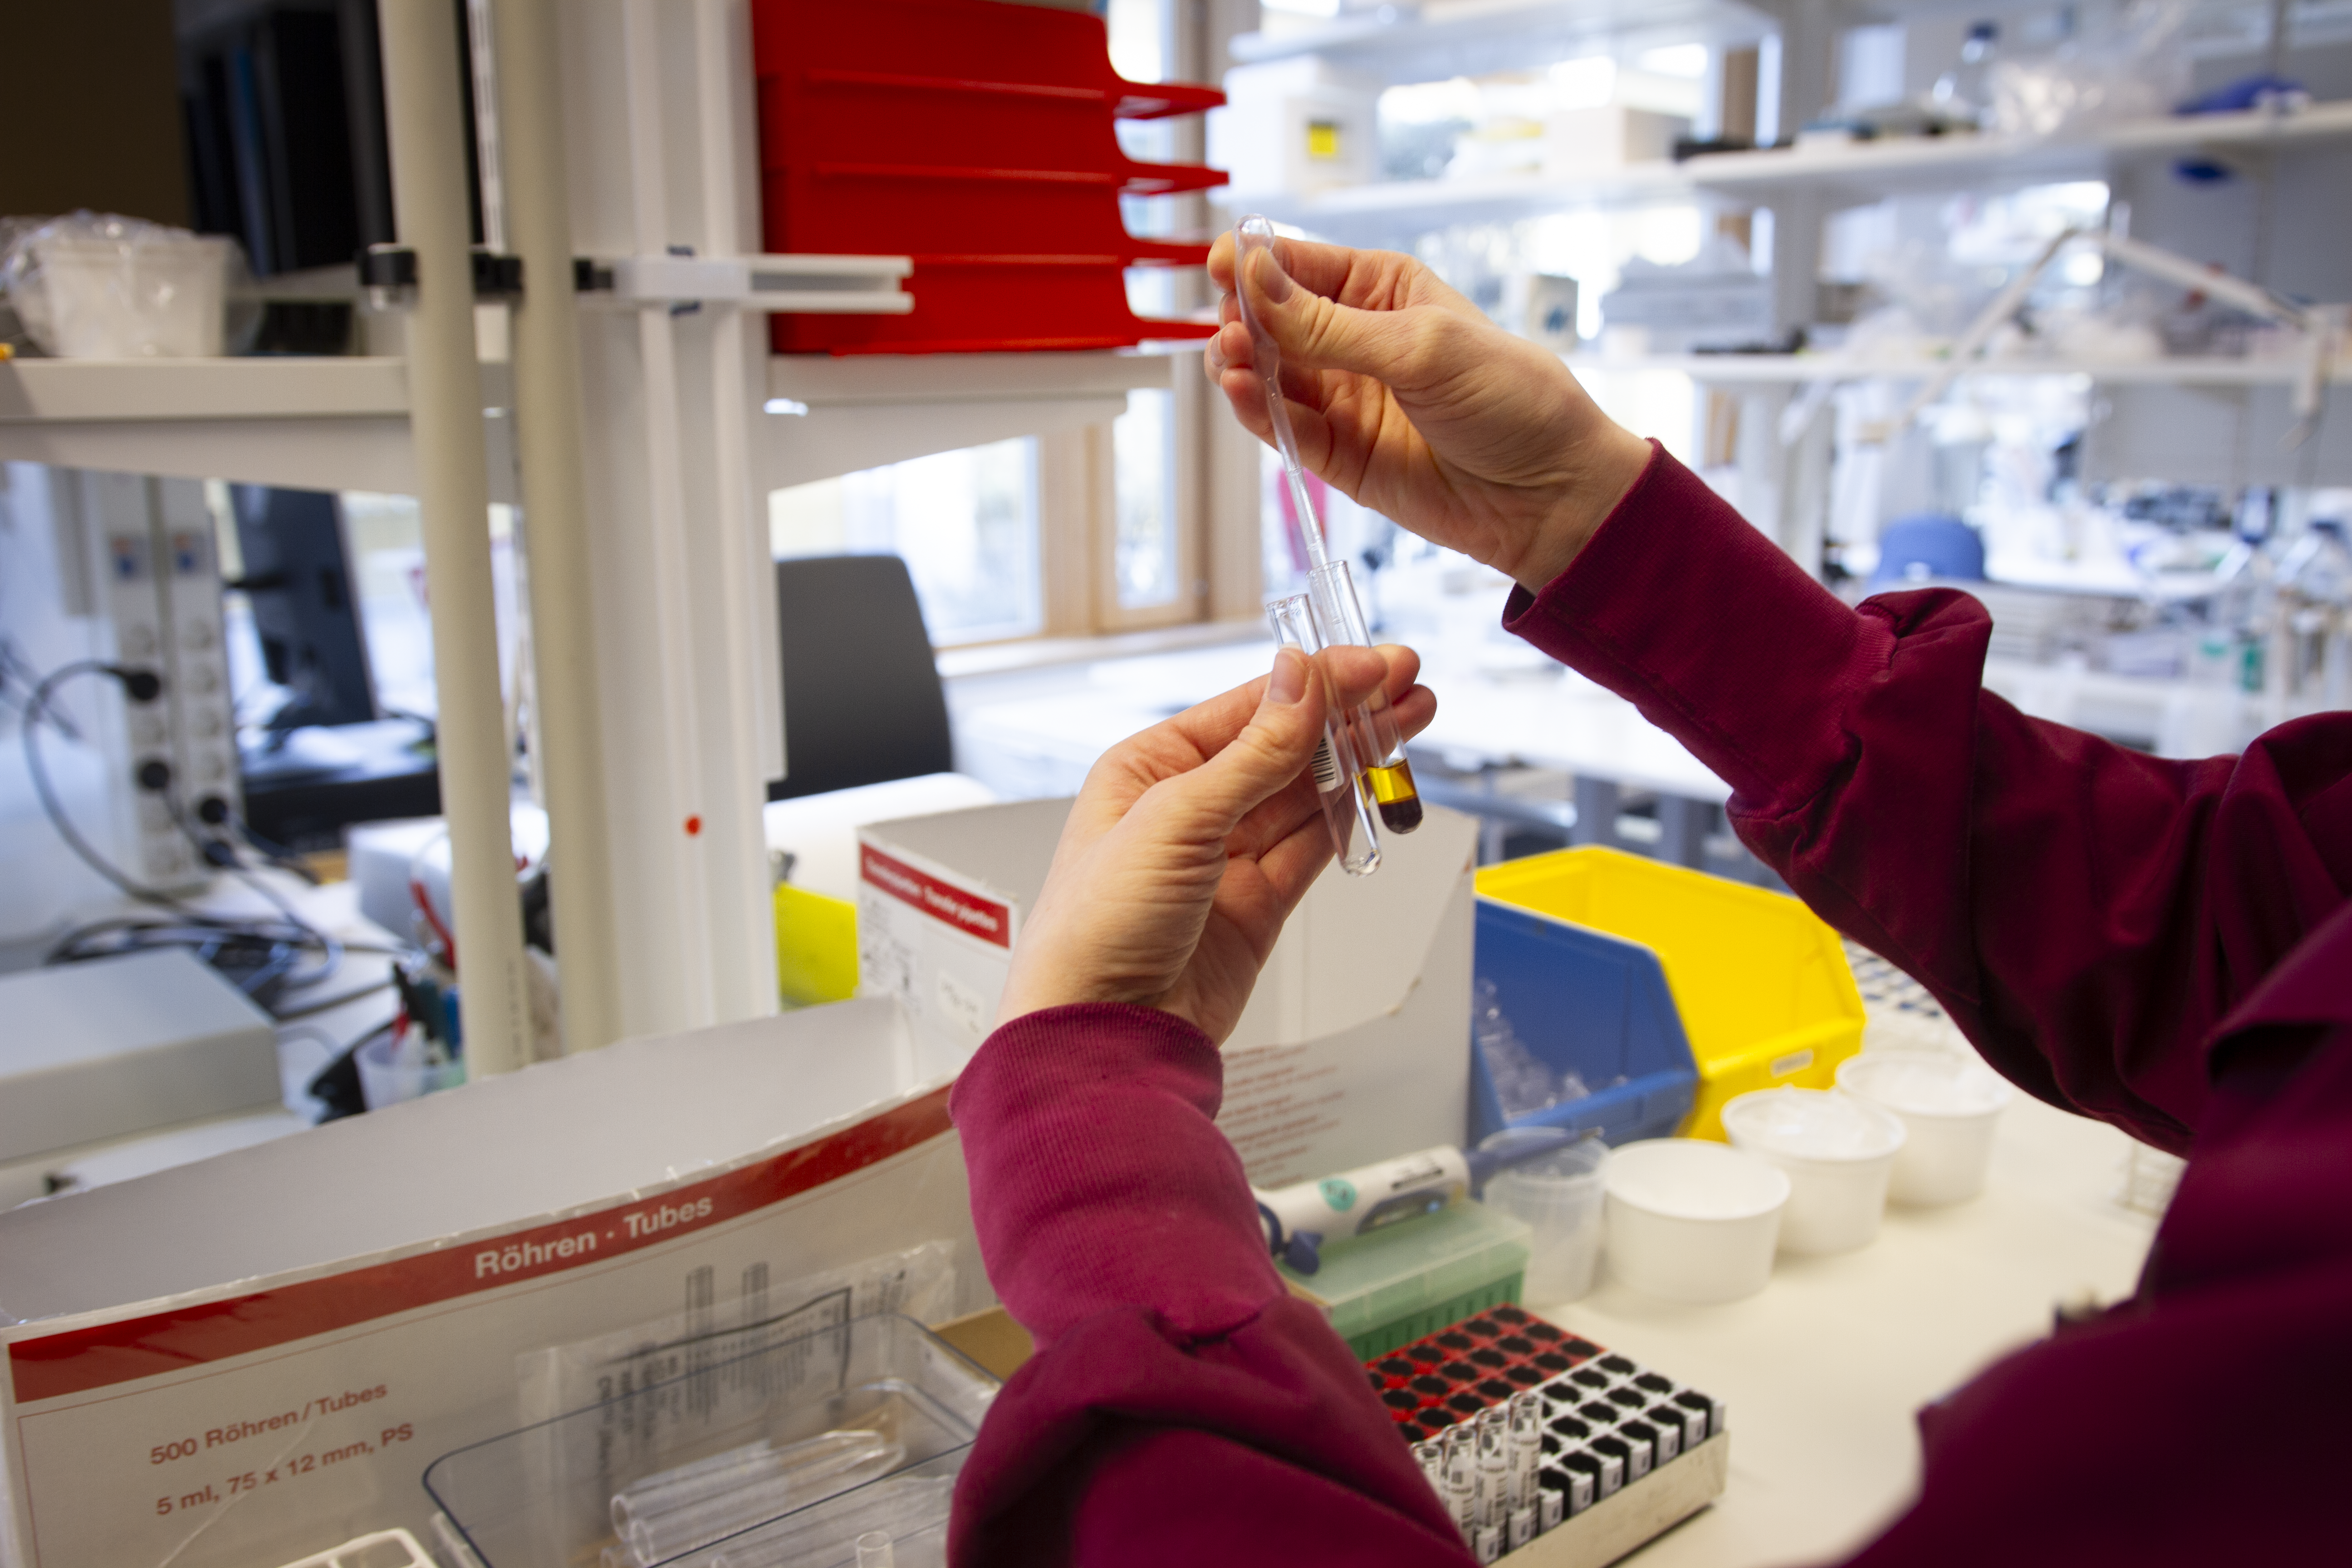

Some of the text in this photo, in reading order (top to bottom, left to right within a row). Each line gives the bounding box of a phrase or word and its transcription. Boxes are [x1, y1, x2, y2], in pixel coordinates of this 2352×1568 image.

[475, 1231, 597, 1279] Röhren
[622, 1196, 714, 1239] Tubes
[150, 1438, 198, 1465] 500
[157, 1423, 414, 1515] 5 ml, 75 x 12 mm, PS
